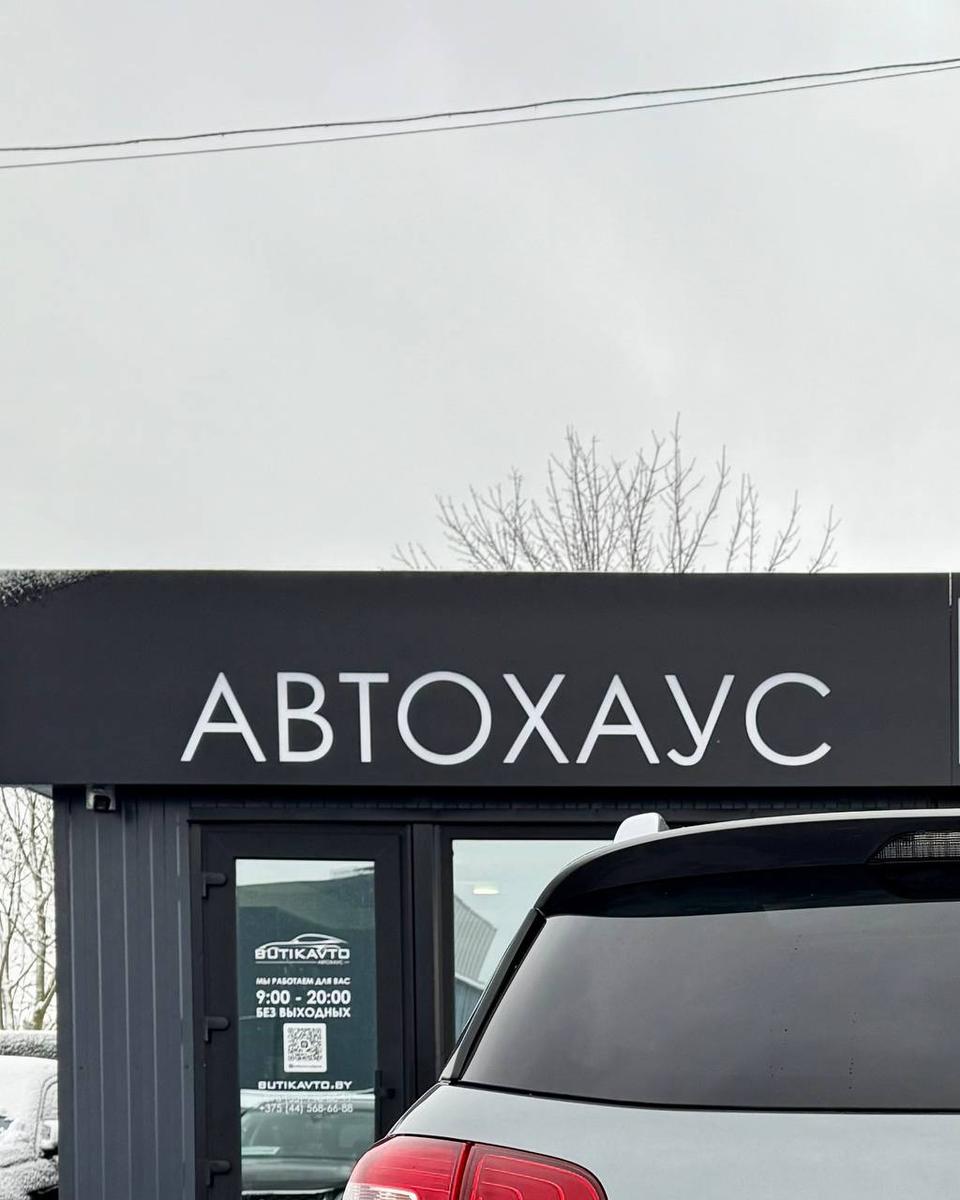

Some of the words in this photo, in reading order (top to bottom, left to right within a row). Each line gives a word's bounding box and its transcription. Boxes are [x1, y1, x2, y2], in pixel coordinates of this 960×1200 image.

[180, 670, 832, 767] АВТОХАУС
[254, 948, 351, 960] BUTIKAVTO
[255, 977, 271, 985] МЫ
[272, 977, 314, 985] РАБОТАЕМ
[315, 977, 332, 986] ДЛЯ
[333, 977, 351, 985] ВАС
[256, 989, 291, 1005] 9:00
[306, 989, 351, 1005] 20:00
[256, 1007, 276, 1018] БЕЗ
[279, 1007, 351, 1019] ВЫХОДНЫХ
[258, 1080, 352, 1090] BUTIKAVTO.BY
[259, 1103, 282, 1113] +375
